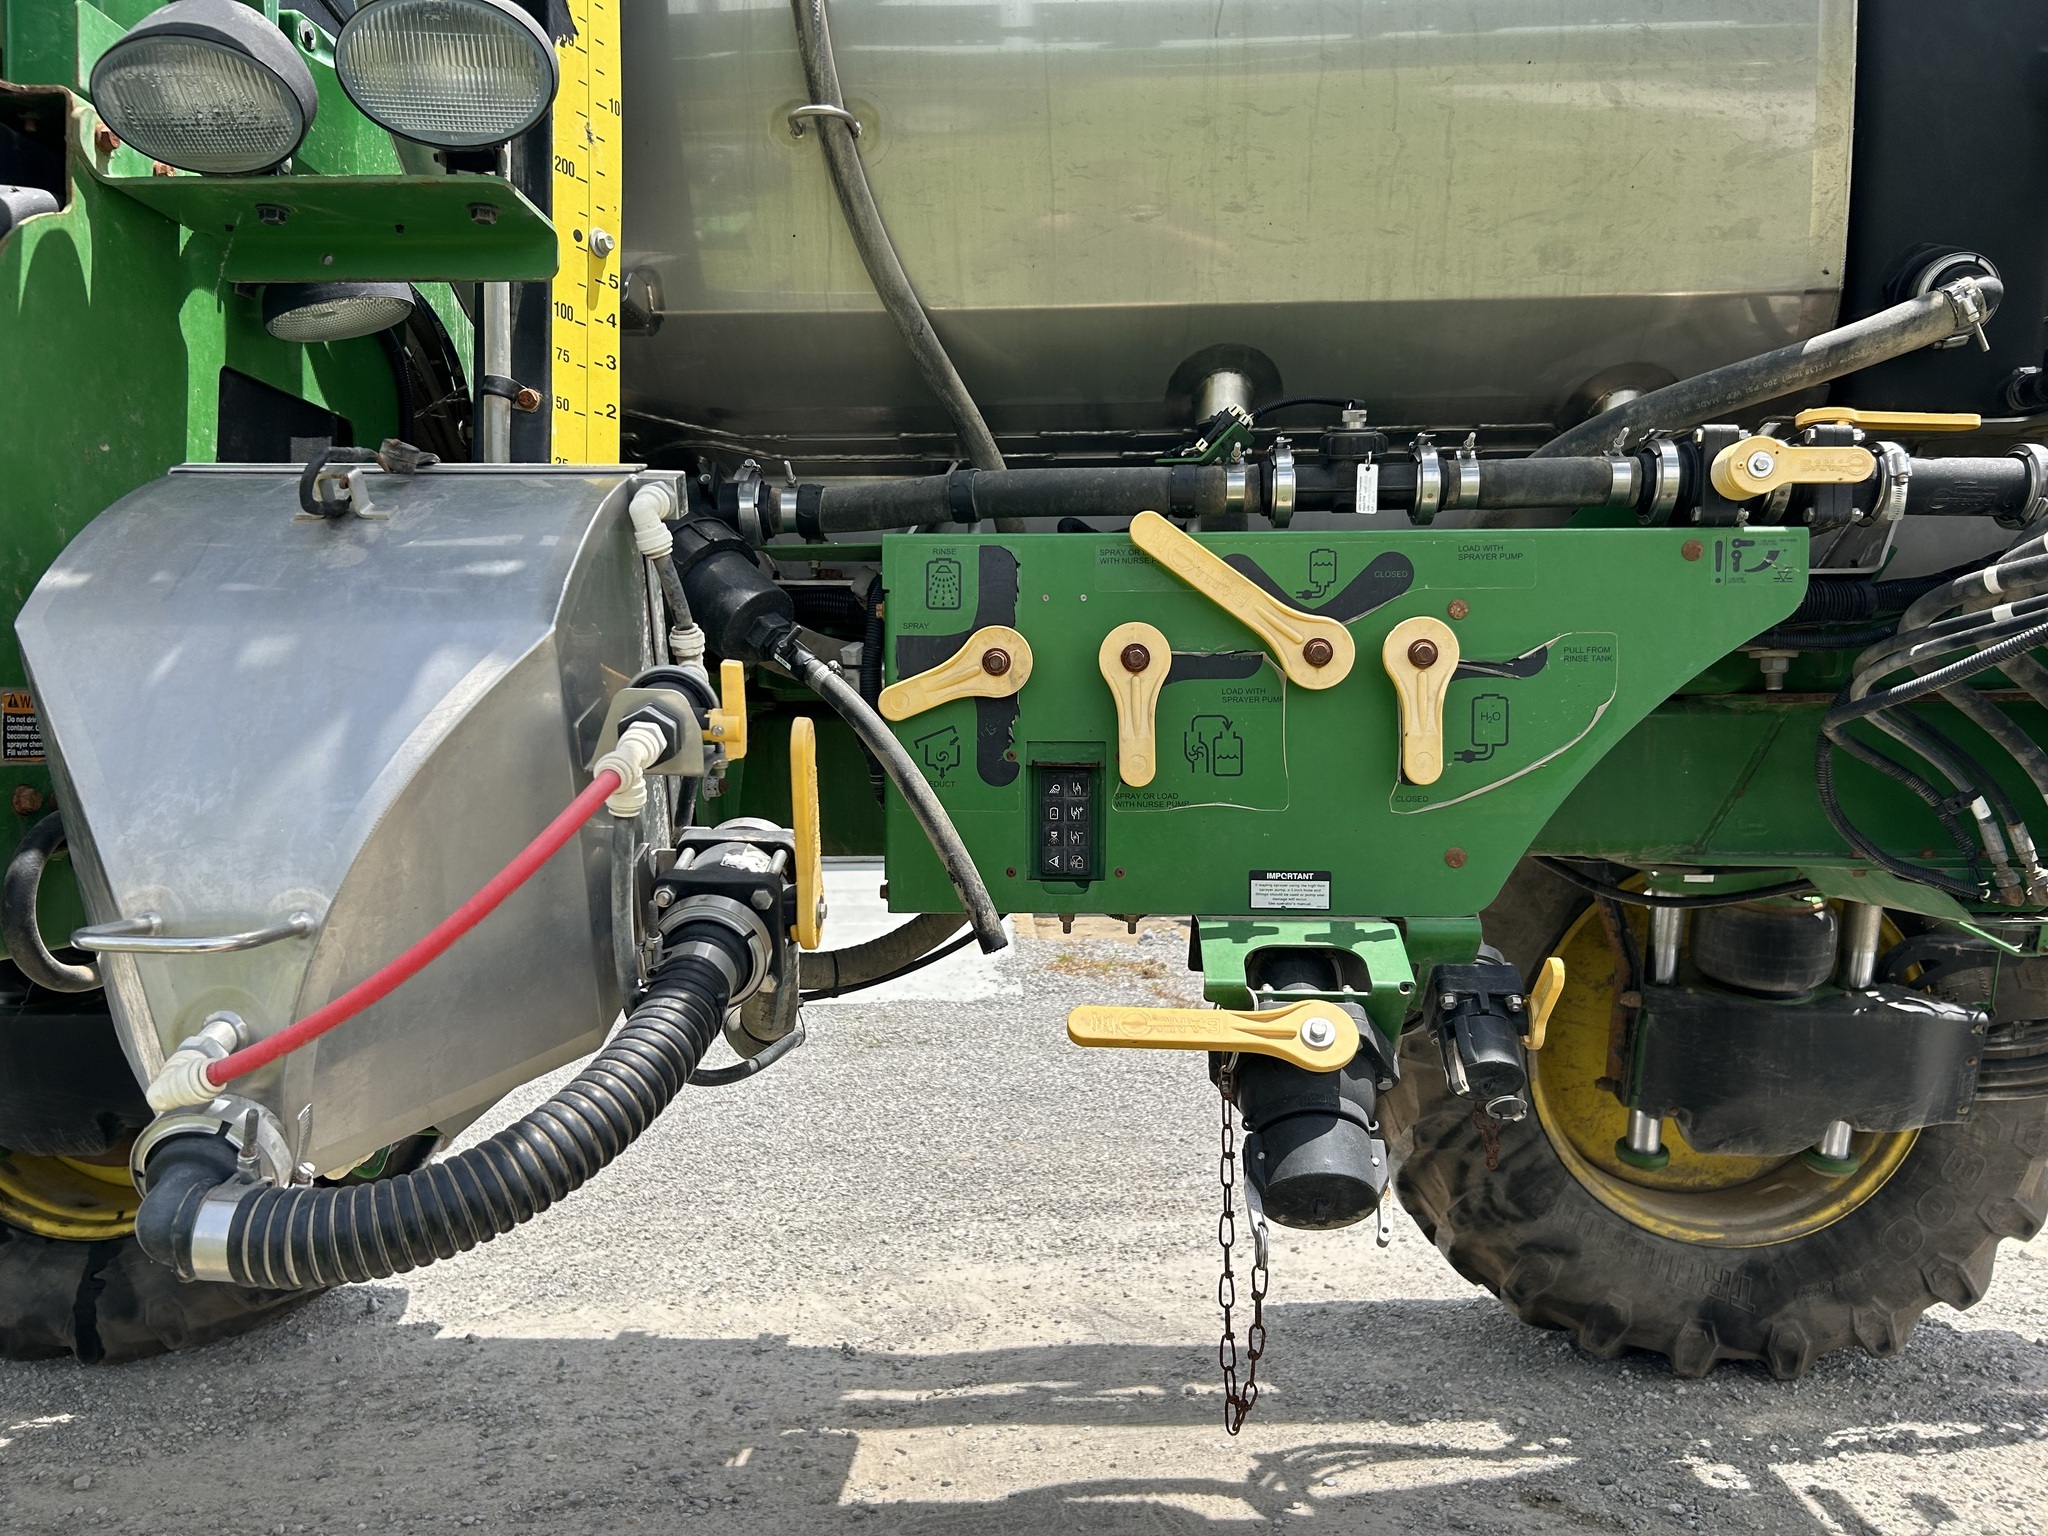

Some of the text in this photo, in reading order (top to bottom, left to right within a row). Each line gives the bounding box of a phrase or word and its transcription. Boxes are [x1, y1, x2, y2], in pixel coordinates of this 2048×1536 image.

[608, 98, 621, 117] 10
[554, 155, 575, 178] 200
[608, 273, 619, 290] 5
[554, 300, 574, 322] 100
[606, 313, 617, 329] 4
[556, 347, 570, 363] 75
[606, 354, 617, 370] 3
[1745, 386, 1759, 394] PSI
[556, 397, 570, 412] 50
[1696, 397, 1720, 410] MADE
[606, 404, 617, 419] 2
[932, 548, 957, 556] RINSE
[1099, 548, 1127, 556] SPRAY
[1128, 548, 1140, 556] OR
[1458, 545, 1482, 553] LOAD
[1458, 552, 1524, 561] SPRAYER PUMP
[1099, 557, 1120, 565] WITH
[1121, 557, 1149, 565] NURSE
[1374, 570, 1408, 578] CLOSED
[902, 622, 930, 630] SPRAY
[1563, 646, 1611, 654] PULL FROM
[6, 741, 28, 749] sprayer
[929, 780, 955, 788] EDUCT
[1115, 792, 1179, 800] SPRAY OR LOAD
[1395, 795, 1429, 803] CLOSED
[1136, 800, 1164, 808] NURSE
[1266, 872, 1314, 880] IMPORTANT
